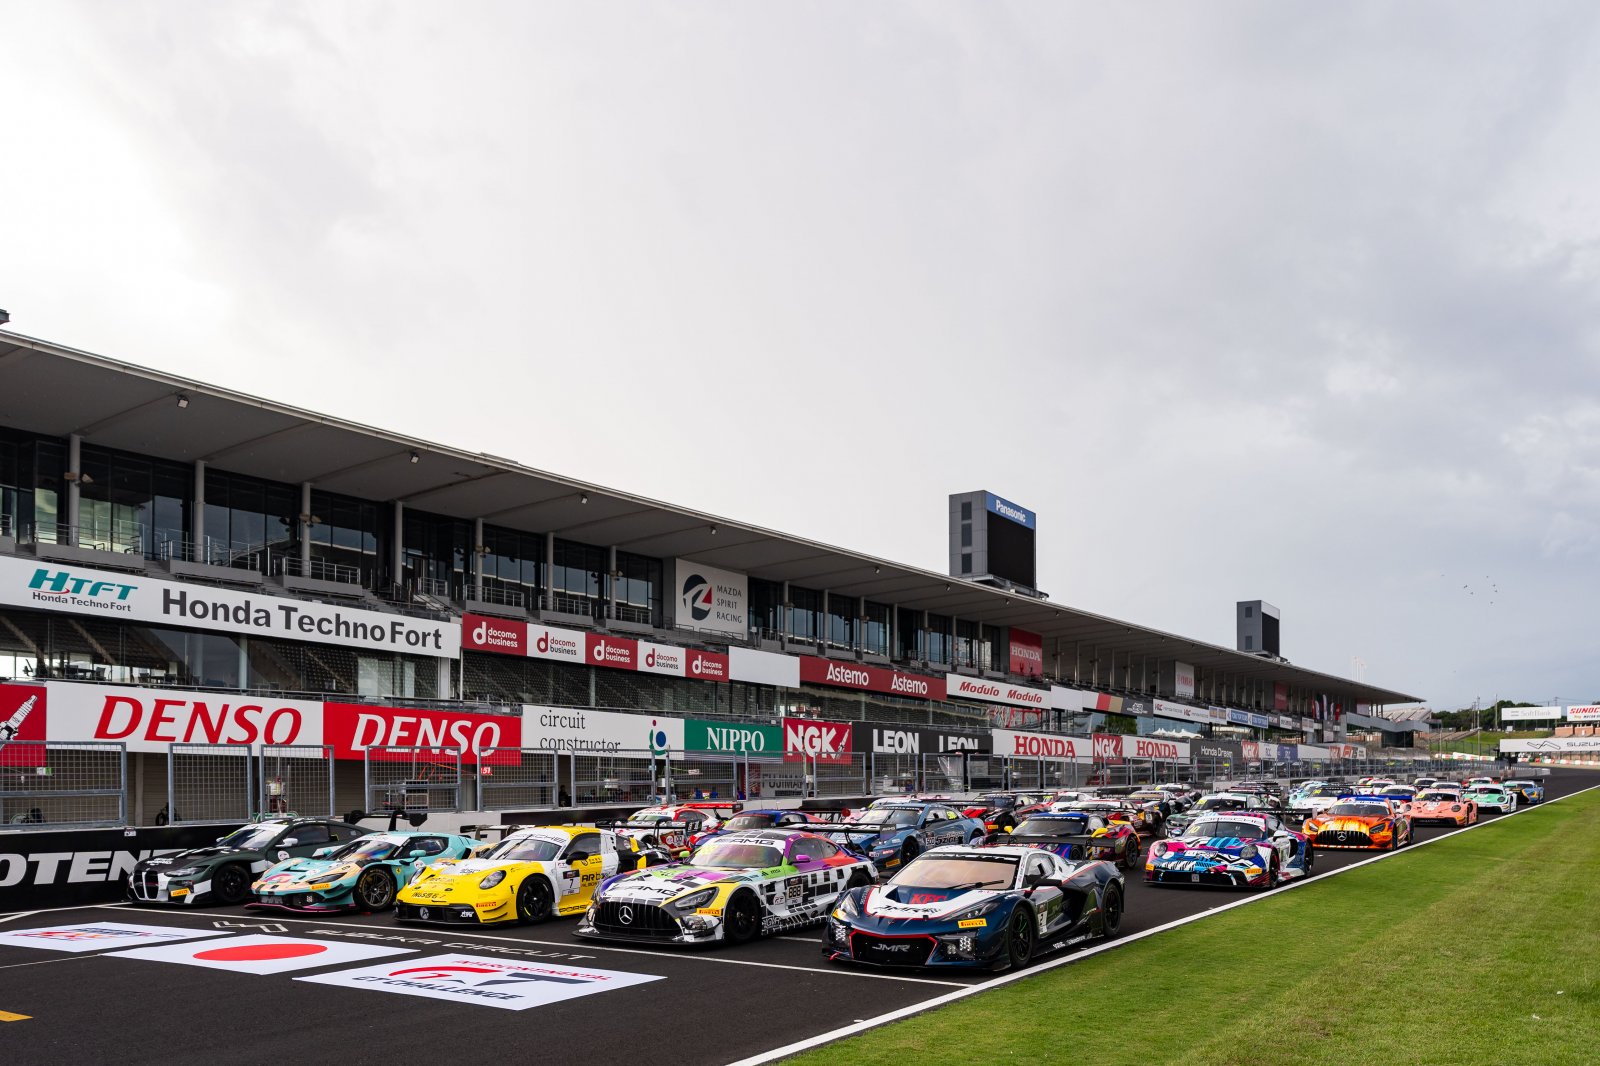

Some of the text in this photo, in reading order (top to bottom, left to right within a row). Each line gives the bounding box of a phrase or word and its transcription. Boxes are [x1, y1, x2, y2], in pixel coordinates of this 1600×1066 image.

[995, 499, 1026, 523] Panasonic
[28, 568, 138, 600] HTFT
[717, 584, 742, 597] MAZDA
[32, 591, 132, 612] Honda Techno Fort
[717, 598, 738, 610] SPIRIT
[163, 588, 442, 650] Honda Techno Fort
[717, 611, 742, 623] RACING
[487, 627, 517, 640] docomo
[488, 637, 518, 648] business
[550, 636, 576, 648] docomo
[605, 644, 630, 656] docomo
[550, 646, 577, 656] business
[605, 653, 631, 664] business
[656, 651, 678, 662] docomo
[1011, 646, 1041, 662] HONDA
[656, 660, 679, 670] business
[702, 659, 722, 669] docomo
[827, 662, 869, 686] Astemo
[891, 670, 928, 694] Astemo
[959, 681, 1000, 697] Modulo
[1007, 689, 1042, 703] Modulo
[94, 695, 302, 746] DENSO
[540, 711, 586, 730] circuit
[350, 713, 501, 757] DENSO
[706, 727, 765, 752] NIPPO
[787, 724, 837, 760] NGK
[873, 729, 920, 754] LEON
[540, 735, 621, 755] constructor
[1014, 735, 1076, 758] HONDA
[1095, 737, 1116, 760] NGK
[1136, 740, 1178, 759] HONDA
[1201, 745, 1217, 756] Honda
[872, 943, 911, 952] JMR
